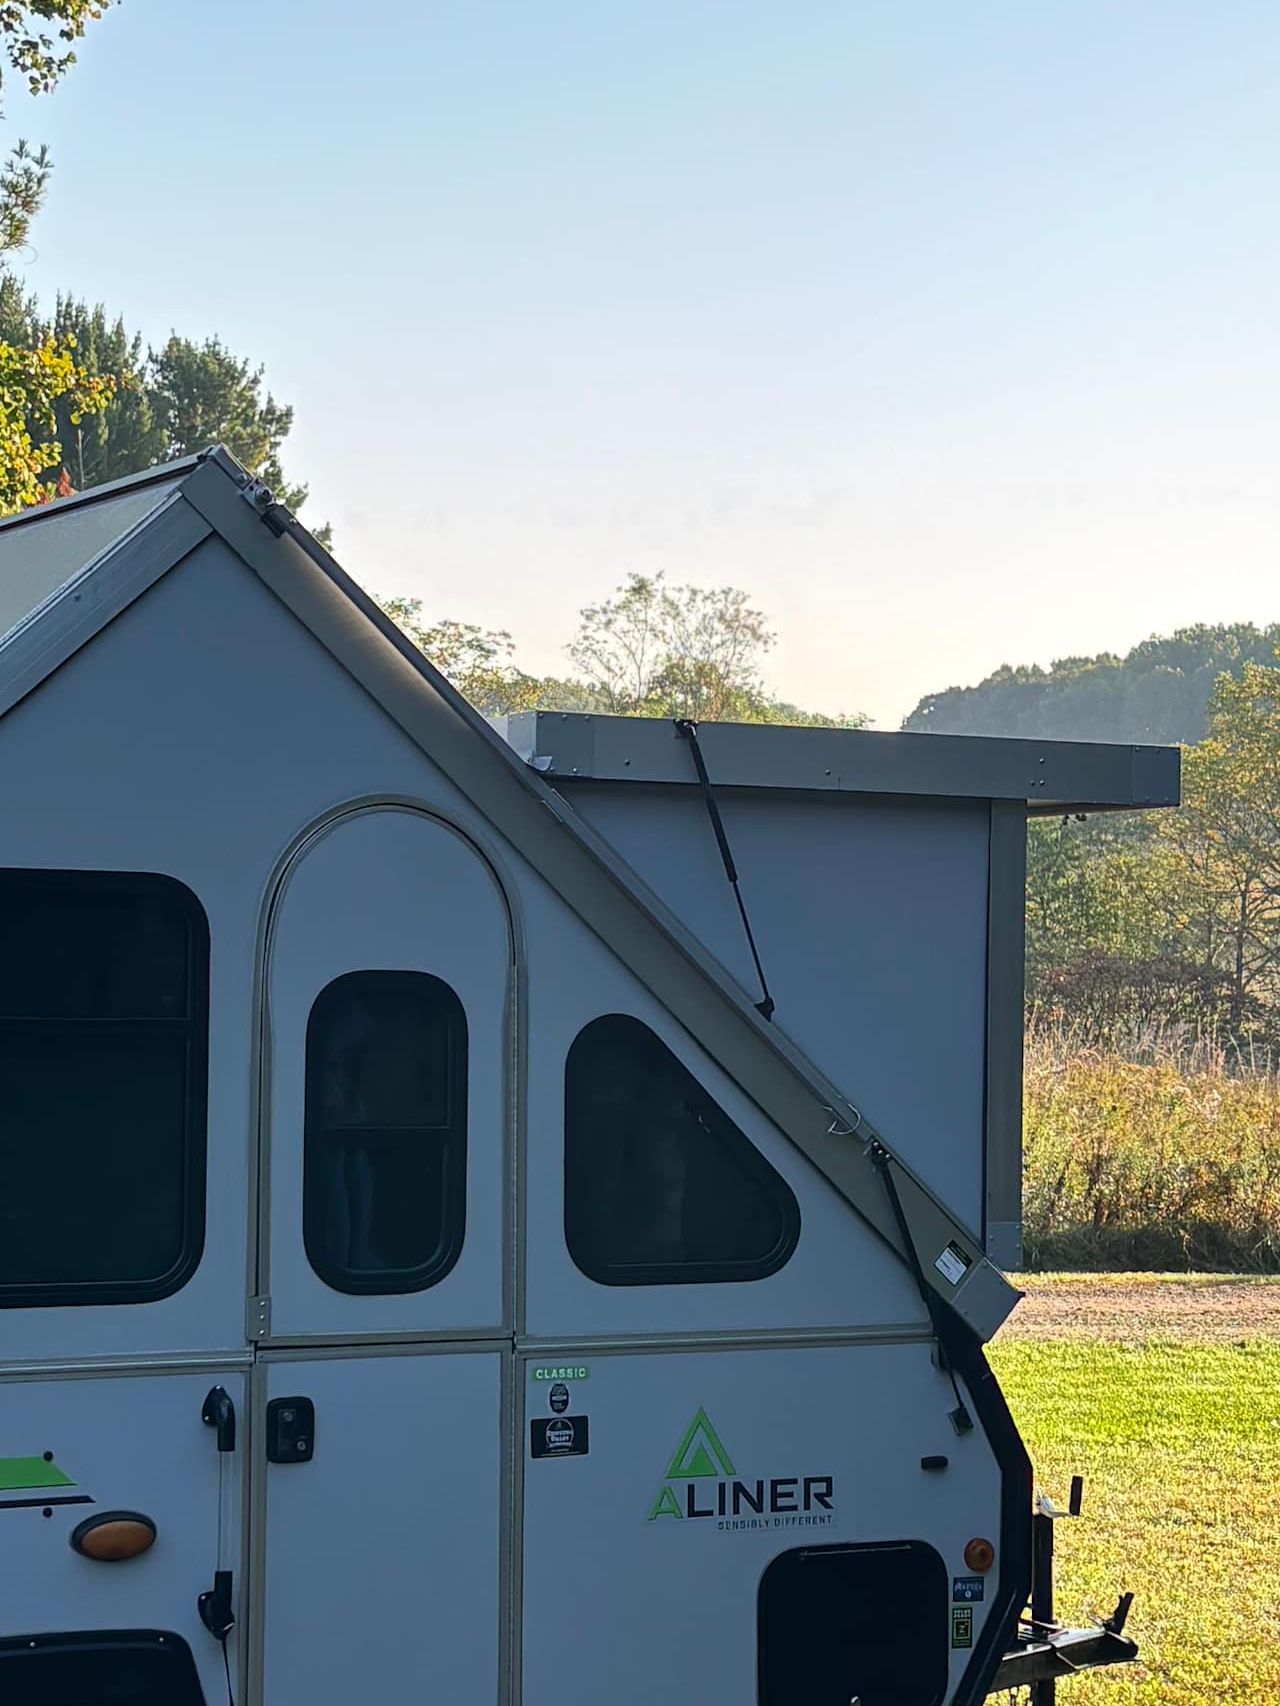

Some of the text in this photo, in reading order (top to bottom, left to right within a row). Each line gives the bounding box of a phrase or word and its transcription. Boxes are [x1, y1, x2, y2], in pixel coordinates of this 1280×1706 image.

[535, 1367, 587, 1380] CLASSIC
[647, 1475, 835, 1521] ALINER
[717, 1514, 833, 1531] SENSIBLY DIFFERENT
